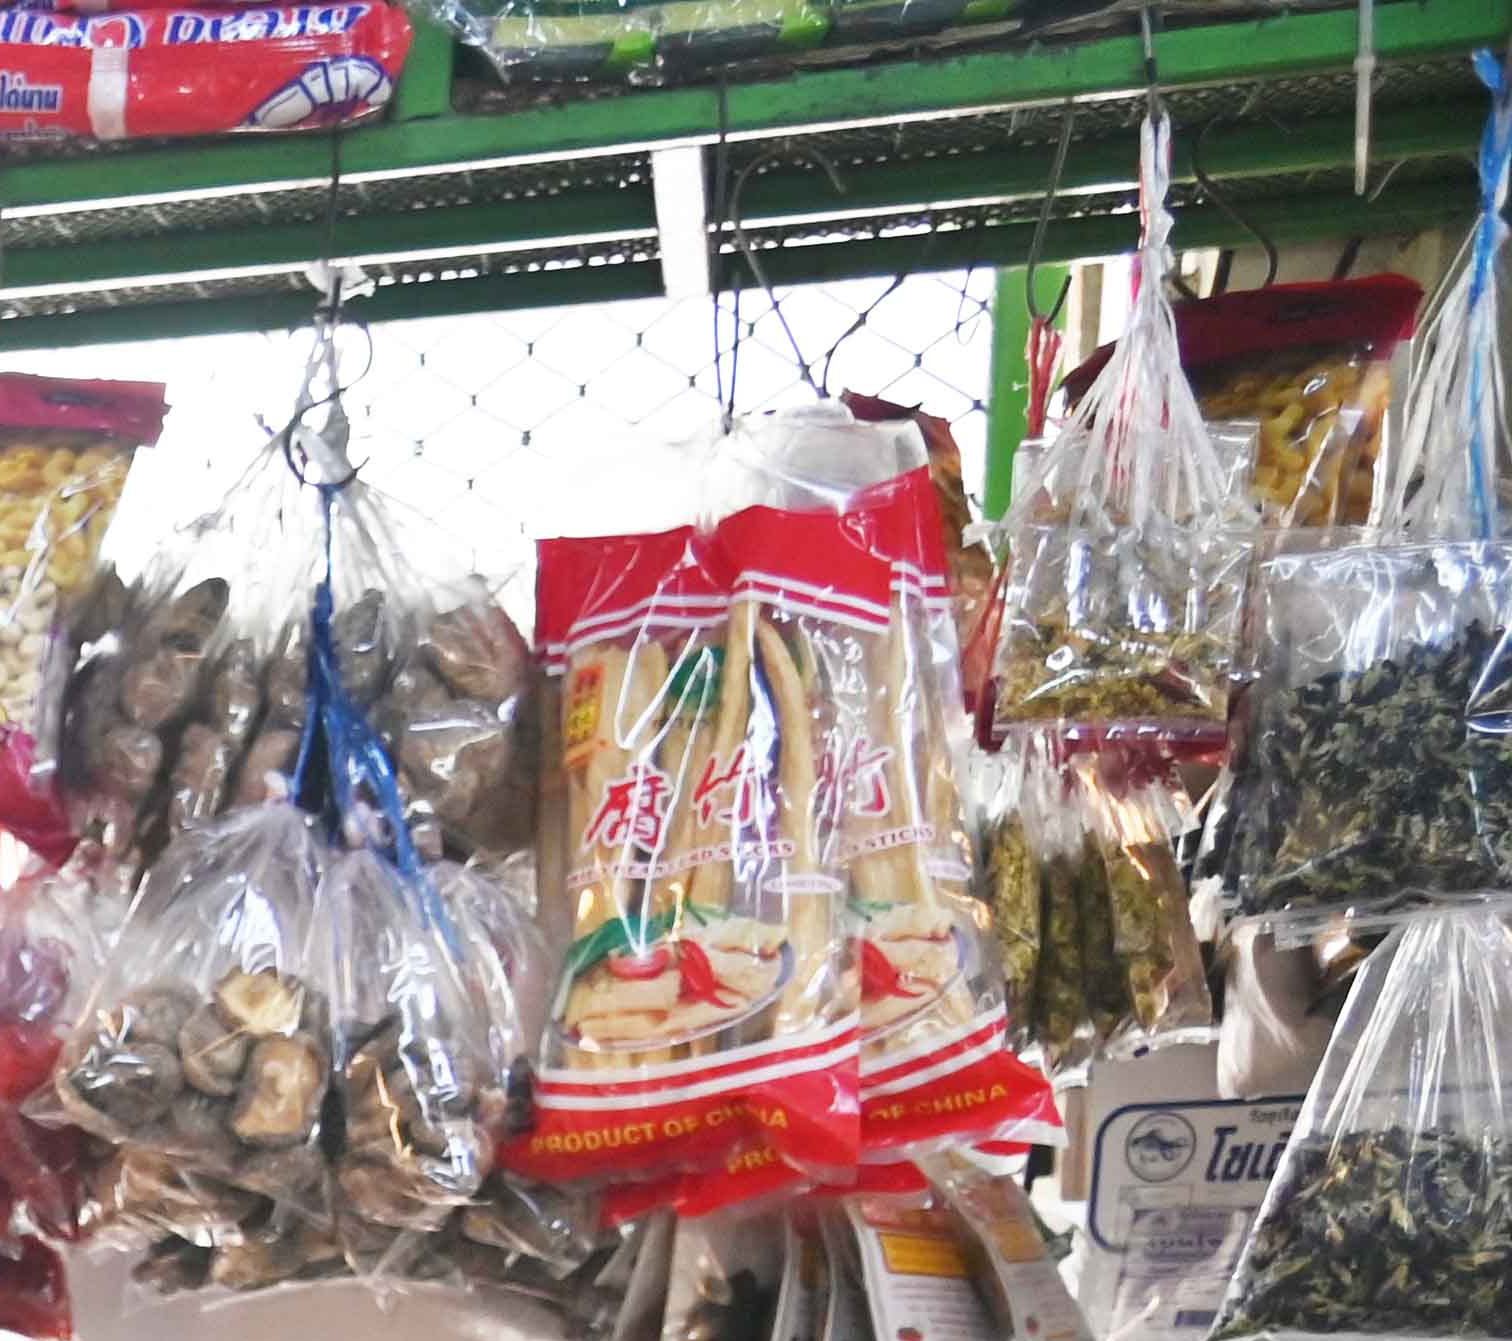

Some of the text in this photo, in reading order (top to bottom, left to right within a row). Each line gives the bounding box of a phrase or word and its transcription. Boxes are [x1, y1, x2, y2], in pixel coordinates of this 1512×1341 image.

[916, 1083, 1009, 1116] CHINA
[530, 1122, 657, 1156] PRODUCT
[664, 1118, 700, 1138] OF
